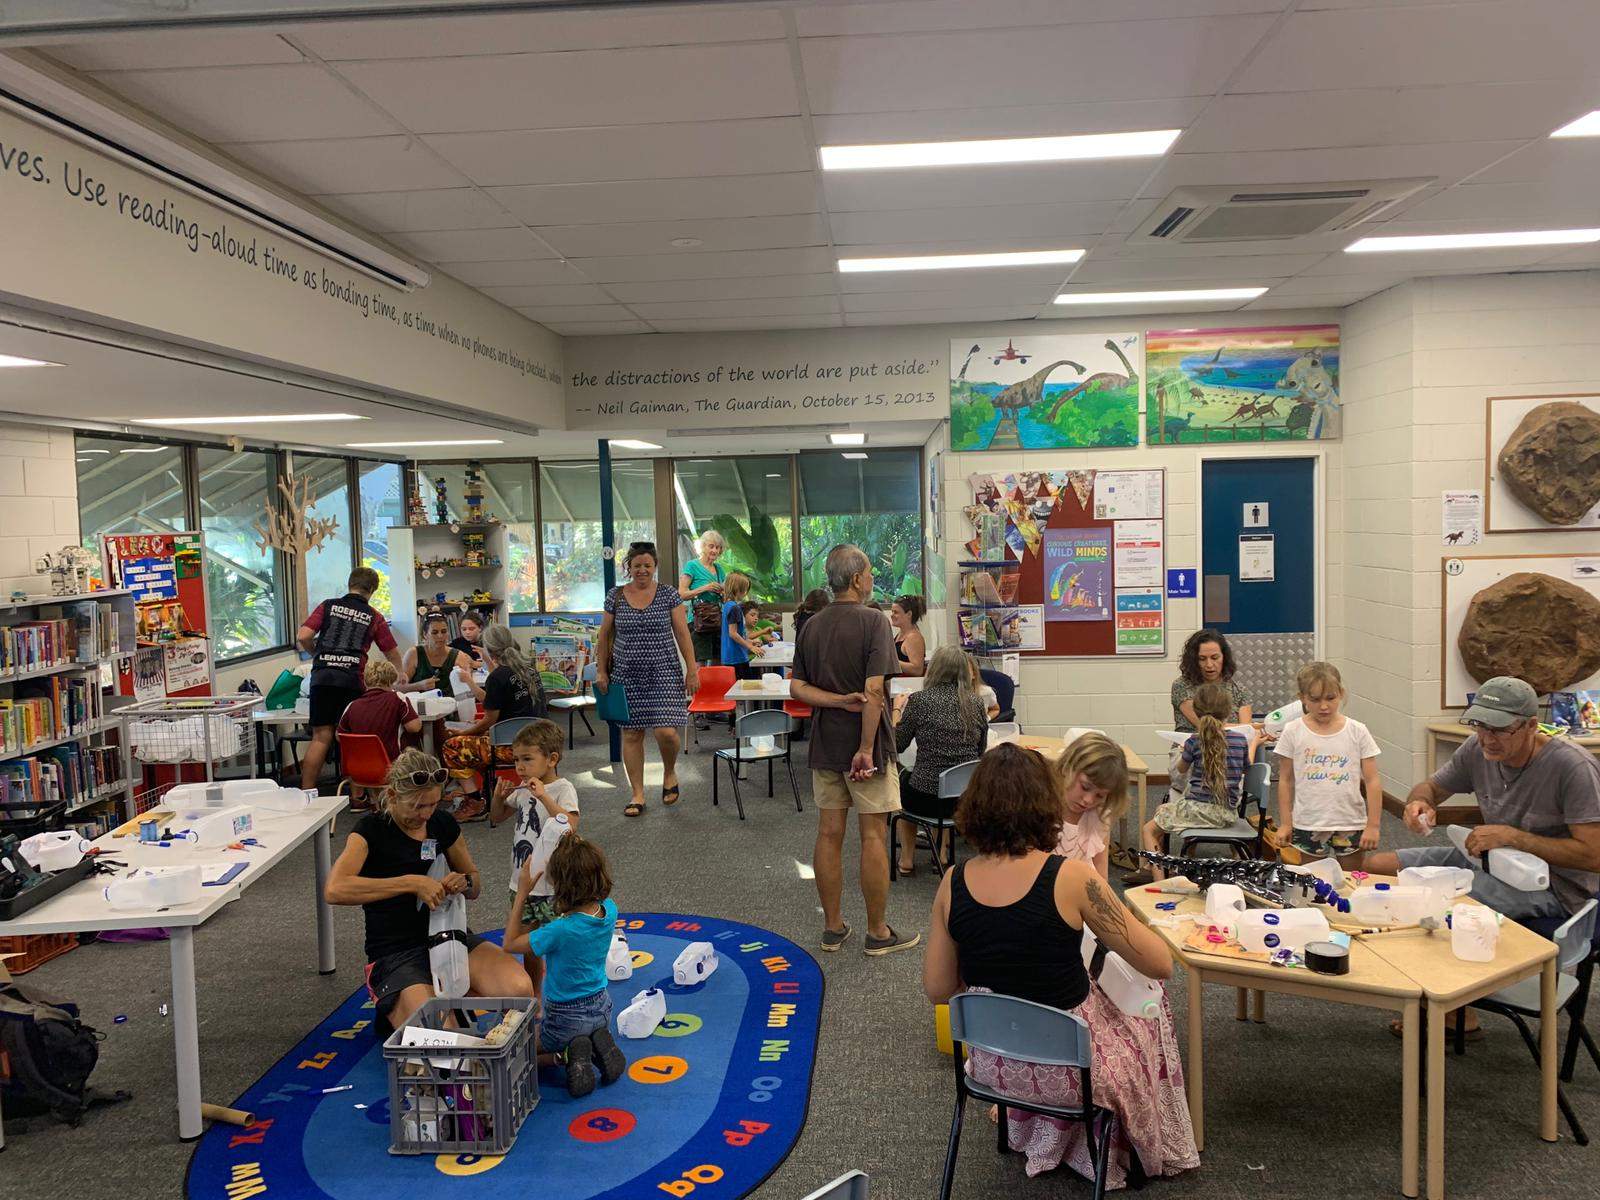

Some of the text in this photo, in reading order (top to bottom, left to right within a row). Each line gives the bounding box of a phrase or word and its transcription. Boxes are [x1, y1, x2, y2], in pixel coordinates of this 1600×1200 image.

[64, 162, 108, 206] Use
[118, 192, 258, 266] reading-aloud
[264, 247, 298, 282] time
[303, 270, 317, 290] as
[322, 268, 369, 317] bonding
[372, 294, 400, 326] time,
[403, 311, 413, 328] as
[415, 311, 436, 337] time
[438, 322, 460, 346] when
[461, 335, 471, 351] no
[473, 336, 497, 360] phones
[572, 371, 599, 387] the
[605, 368, 700, 386] distractions
[707, 365, 724, 383] of
[728, 366, 755, 383] the
[762, 363, 810, 381] world
[816, 366, 843, 380] are
[849, 363, 878, 382] put
[597, 401, 624, 415] Neil
[628, 399, 690, 416] Gaiman,
[696, 398, 720, 413] The
[726, 395, 798, 412] Guardian,
[802, 393, 859, 409] October
[864, 393, 889, 408] 15,
[894, 391, 936, 405] 2013
[1047, 546, 1107, 557] WILD MINDS
[331, 604, 373, 621] ROEBUCK
[319, 654, 361, 665] LEAVERS
[1304, 747, 1350, 768] Happy
[766, 1003, 797, 1028] Mm
[330, 1020, 372, 1040] Aa
[758, 1039, 791, 1063] Nn
[643, 1066, 674, 1076] 7
[748, 1076, 783, 1103] Oo
[587, 1116, 619, 1132] 8
[722, 1119, 772, 1147] Pp
[657, 1164, 724, 1199] Qq
